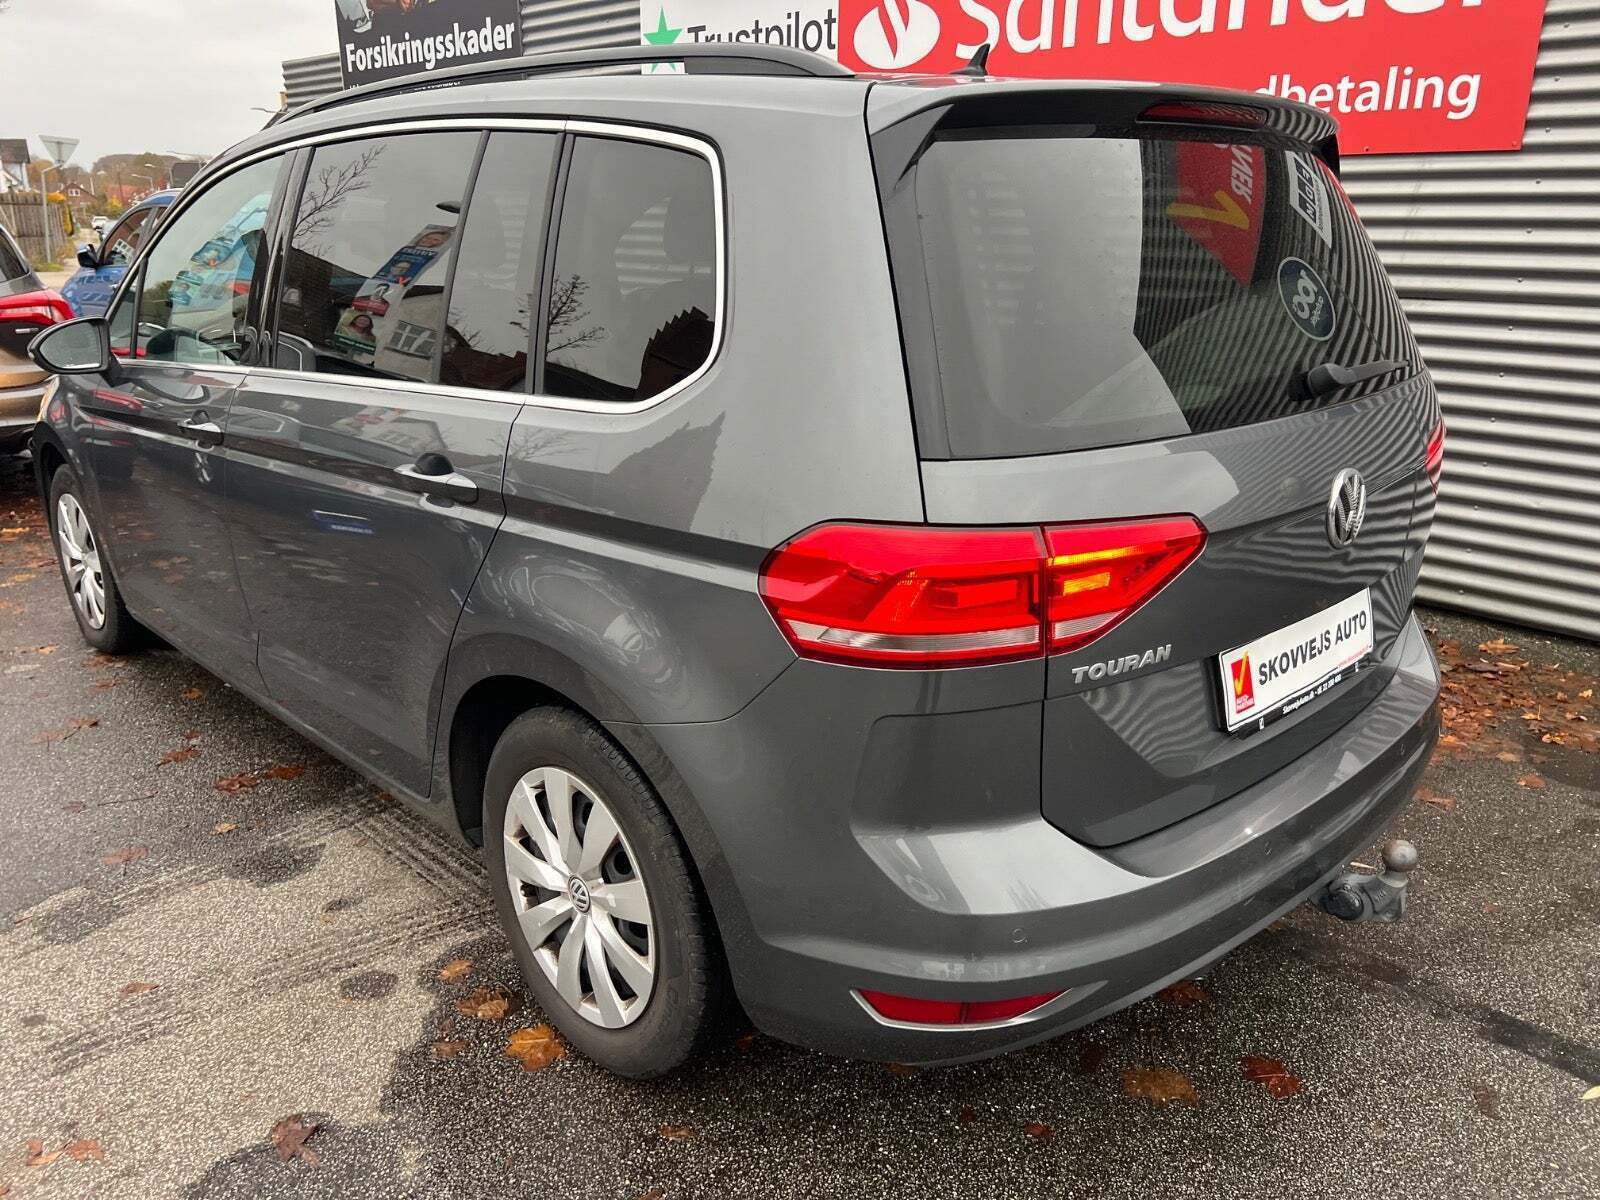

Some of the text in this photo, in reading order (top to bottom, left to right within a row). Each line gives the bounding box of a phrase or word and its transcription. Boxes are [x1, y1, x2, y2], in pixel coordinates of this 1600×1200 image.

[345, 17, 515, 70] Forsikringsskader
[1071, 644, 1172, 684] TOURAN
[1259, 629, 1332, 686] SKOVVEJS
[1334, 610, 1367, 646] AUTO
